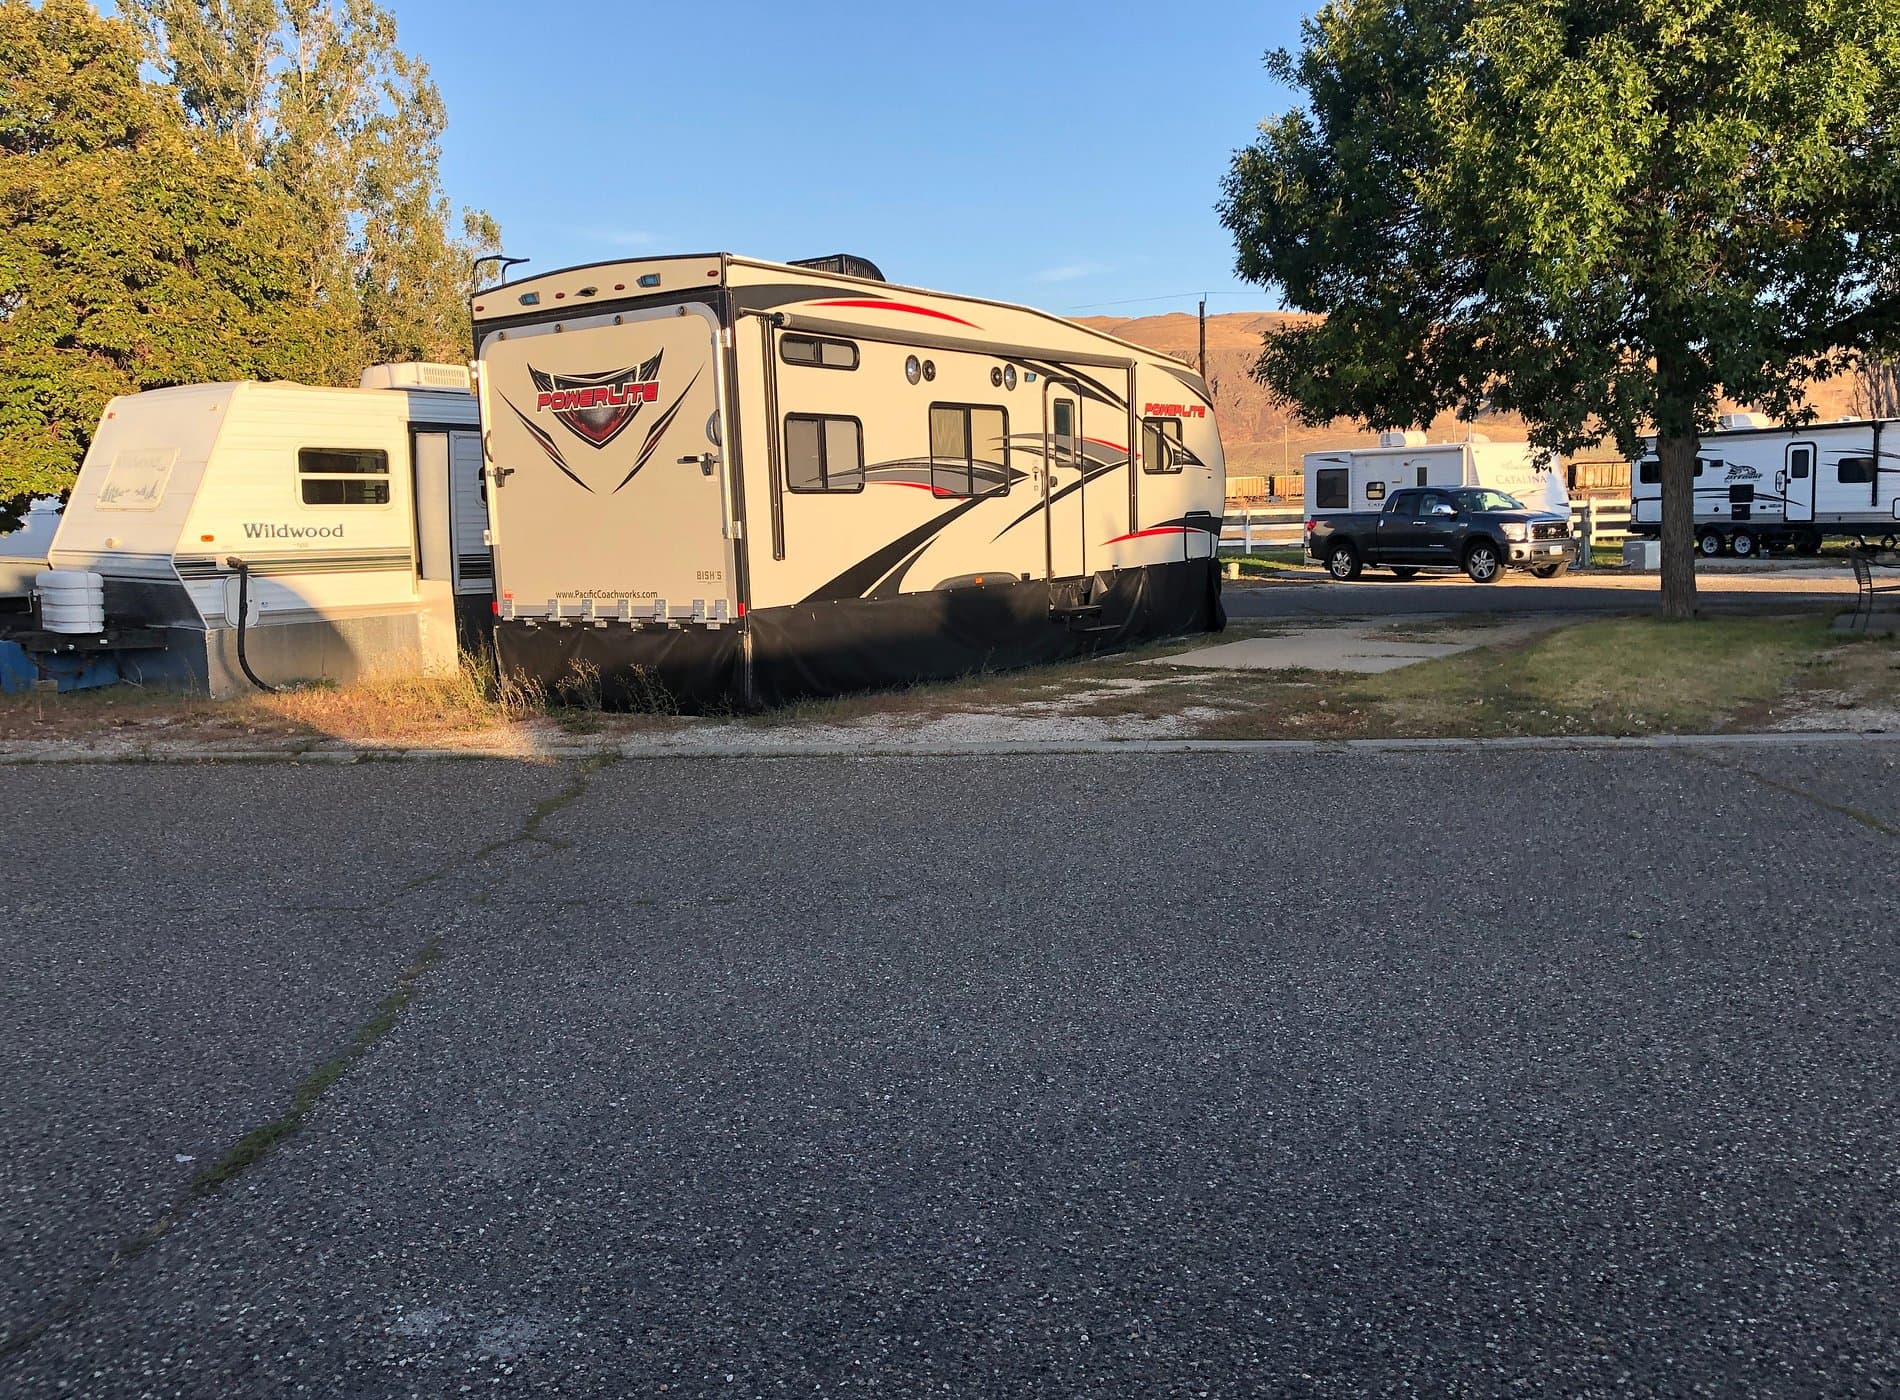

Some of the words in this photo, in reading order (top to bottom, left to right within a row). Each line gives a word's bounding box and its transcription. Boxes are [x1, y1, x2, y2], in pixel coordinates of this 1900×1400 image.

[536, 380, 660, 413] POWERLITE
[1144, 403, 1206, 418] POWERLITE
[242, 522, 345, 539] Wildwood
[696, 570, 722, 580] BISH'S
[555, 589, 658, 599] www.PacificCoachworks.com
